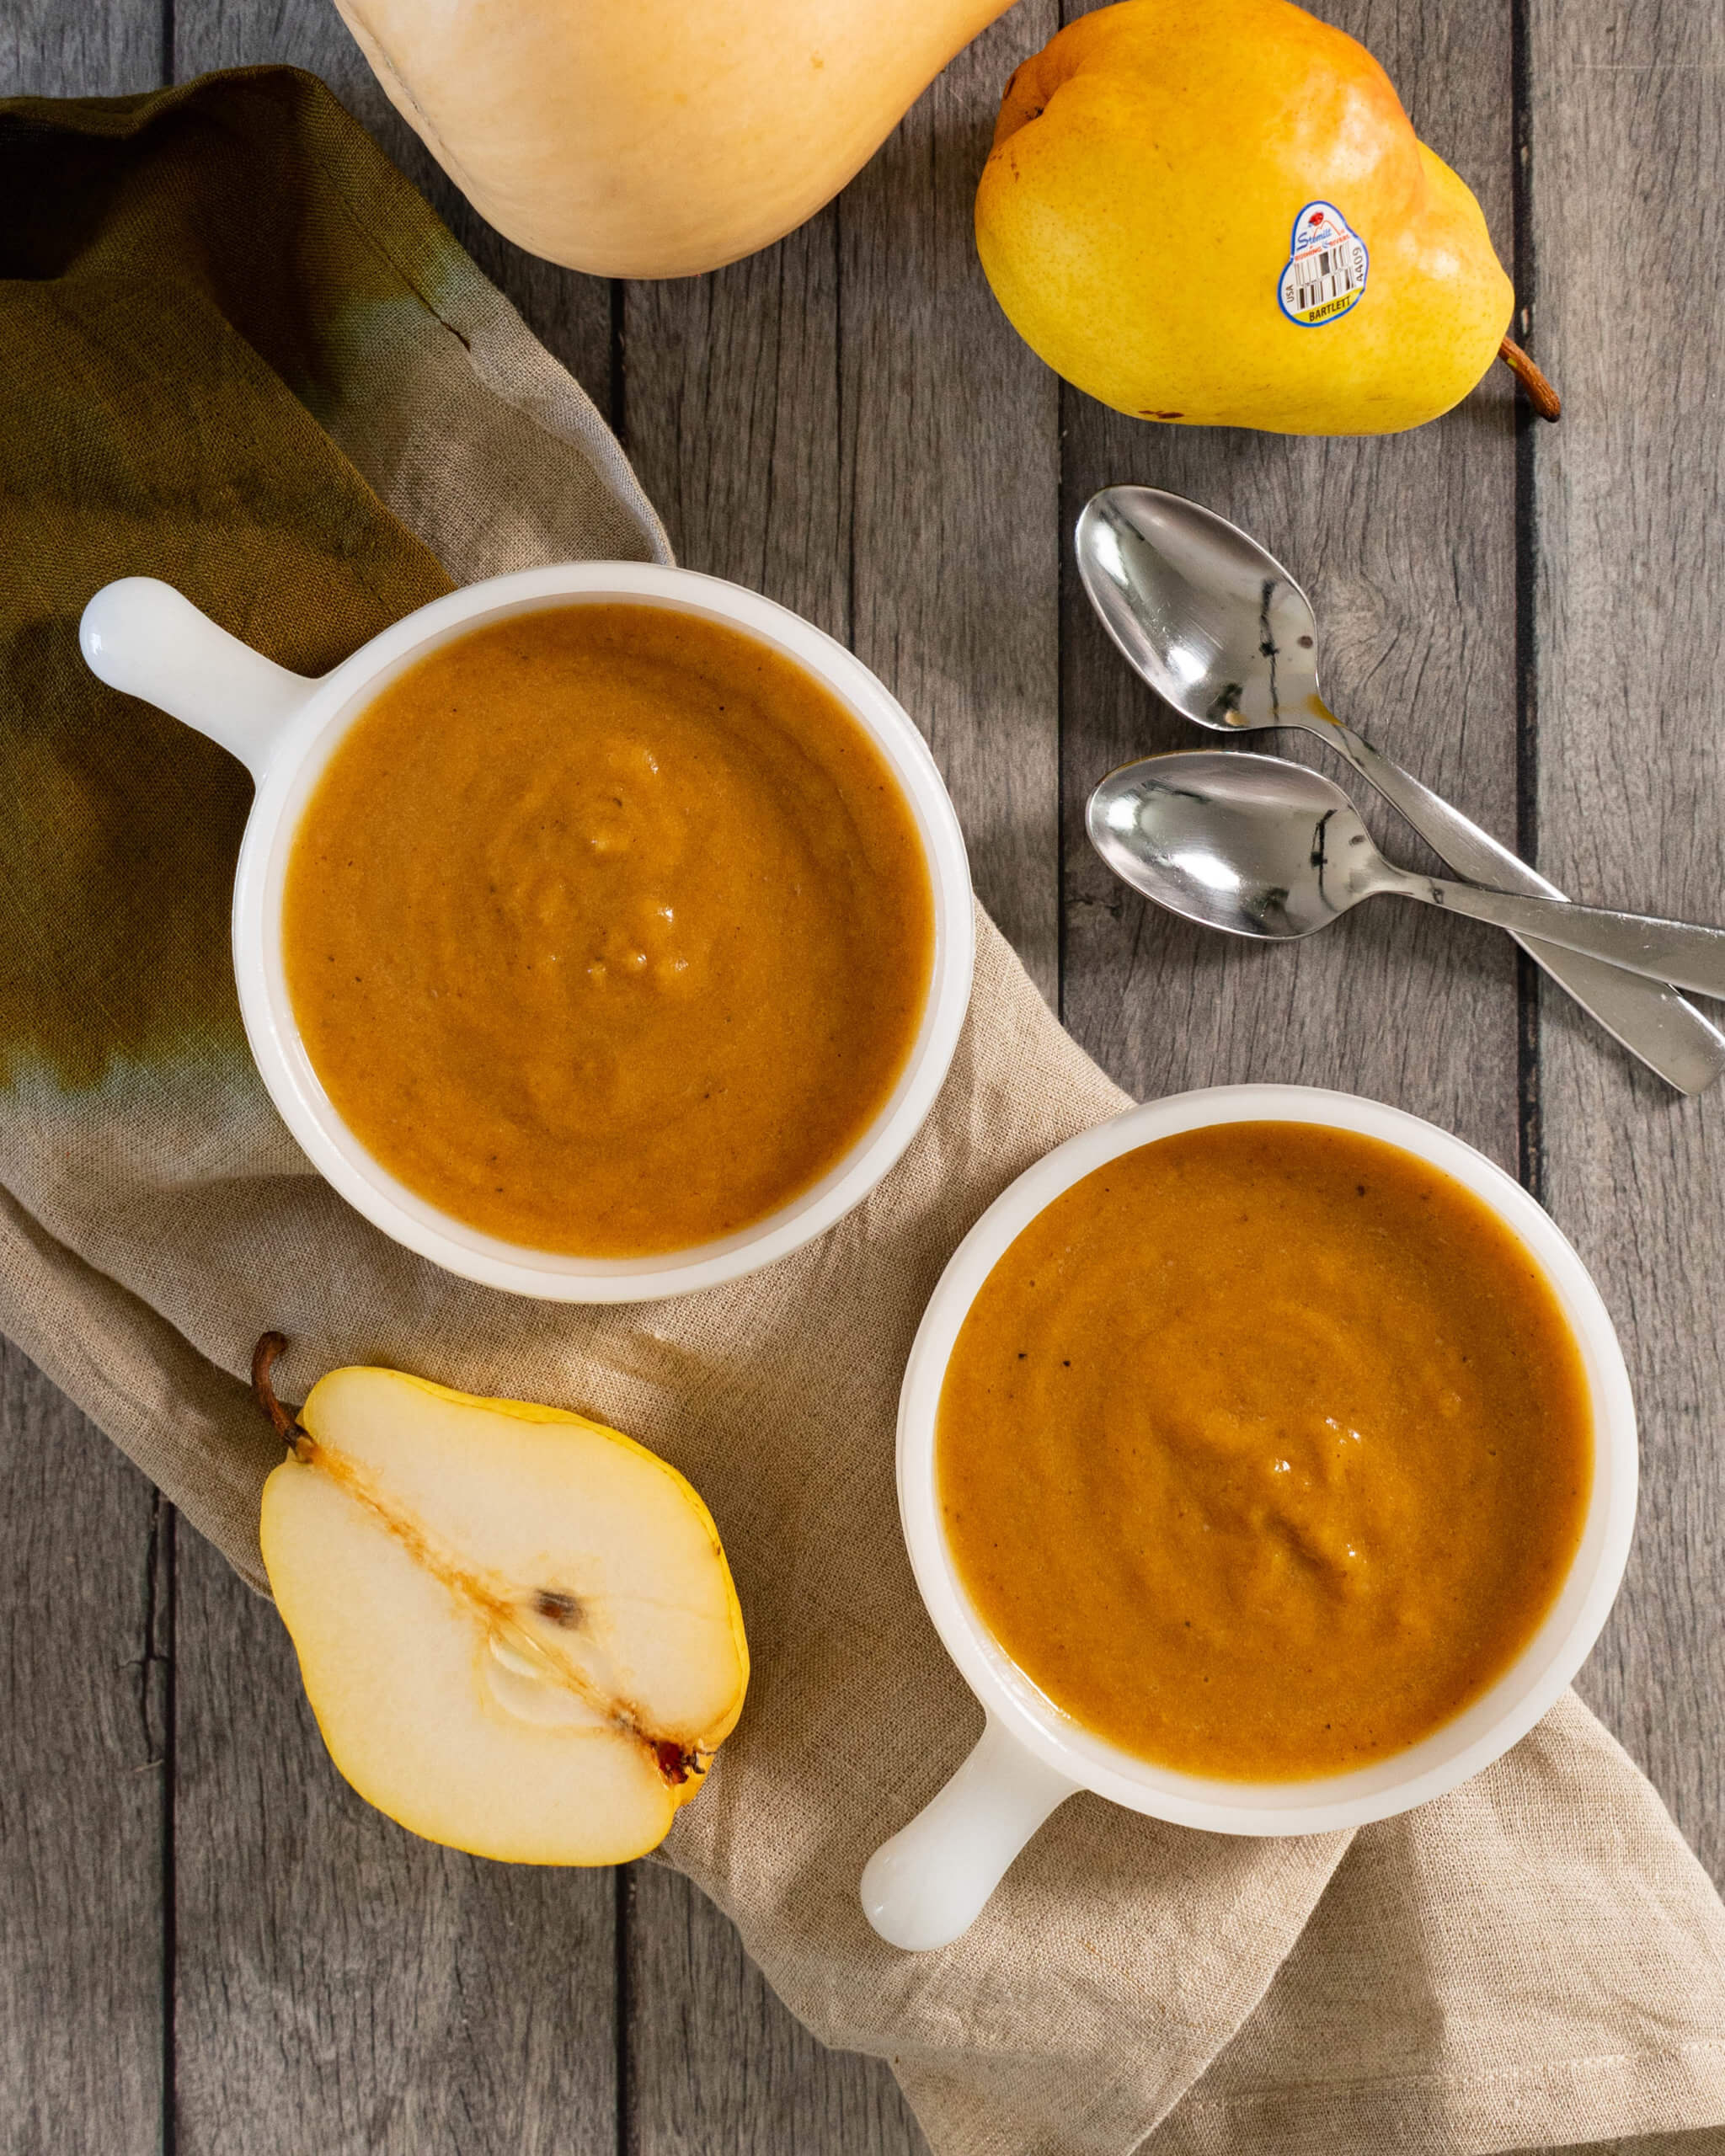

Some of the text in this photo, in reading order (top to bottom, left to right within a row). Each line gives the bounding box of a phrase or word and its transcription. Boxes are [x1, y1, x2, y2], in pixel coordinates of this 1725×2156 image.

[1296, 228, 1332, 251] Stemilt
[1353, 247, 1363, 282] 4409
[1285, 284, 1295, 303] USA
[1309, 296, 1351, 322] BARTLETT
